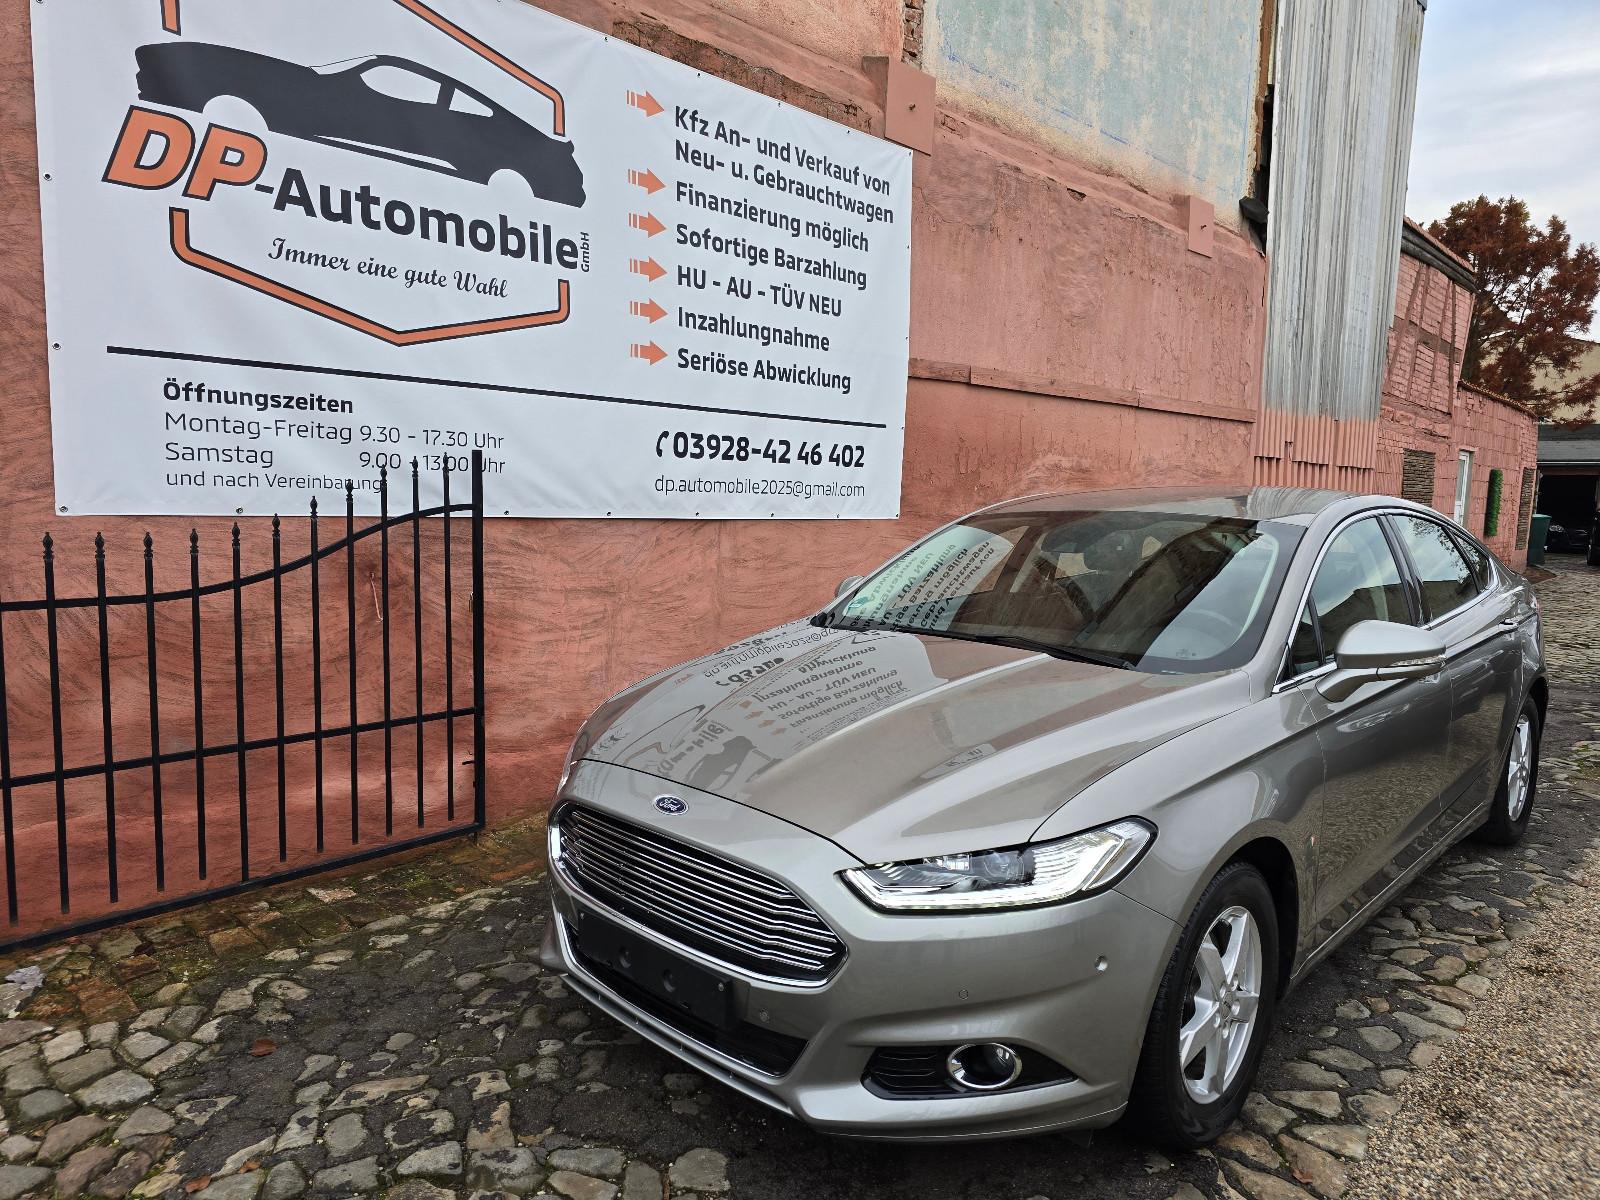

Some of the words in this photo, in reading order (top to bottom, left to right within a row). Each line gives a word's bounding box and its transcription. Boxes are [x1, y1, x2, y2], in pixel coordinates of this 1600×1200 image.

[675, 105, 709, 137] Kfz
[714, 121, 750, 147] An-
[757, 137, 791, 163] und
[795, 146, 859, 185] Verkauf
[863, 174, 890, 196] von
[101, 104, 578, 270] DP-Automobile
[675, 139, 724, 171] Neu-
[731, 161, 749, 181] u.
[753, 164, 894, 223] Gebrauchtwagen
[676, 181, 801, 237] Finanzierung
[805, 221, 869, 251] möglich
[268, 238, 349, 272] Immer
[357, 257, 398, 279] eine
[405, 266, 447, 288] gute
[454, 271, 508, 298] Wahl
[580, 232, 590, 273] GmbH
[676, 224, 768, 266] Sofortige
[774, 248, 867, 290] Barzahlung
[677, 265, 706, 289] HU
[726, 276, 752, 299] AU
[770, 283, 805, 310] TÜV
[809, 294, 842, 316] NEU
[678, 307, 829, 351] Inzahlungnahme
[677, 348, 748, 376] Seriöse
[753, 360, 851, 394] Abwicklung
[163, 377, 353, 414] Öffnungszeiten
[165, 412, 352, 443] Montag-Freitag
[360, 426, 400, 443] 9.30
[423, 429, 468, 447] 17.30
[474, 432, 504, 449] Uhr
[673, 431, 791, 464] 03928-42
[797, 441, 822, 466] 46
[828, 443, 865, 467] 402
[165, 442, 273, 468] Samstag
[360, 452, 401, 469] 9.00
[423, 455, 469, 472] 1300
[167, 471, 205, 487] und
[213, 471, 259, 488] nach
[655, 475, 865, 499] dp.automobile2025@gmail.com
